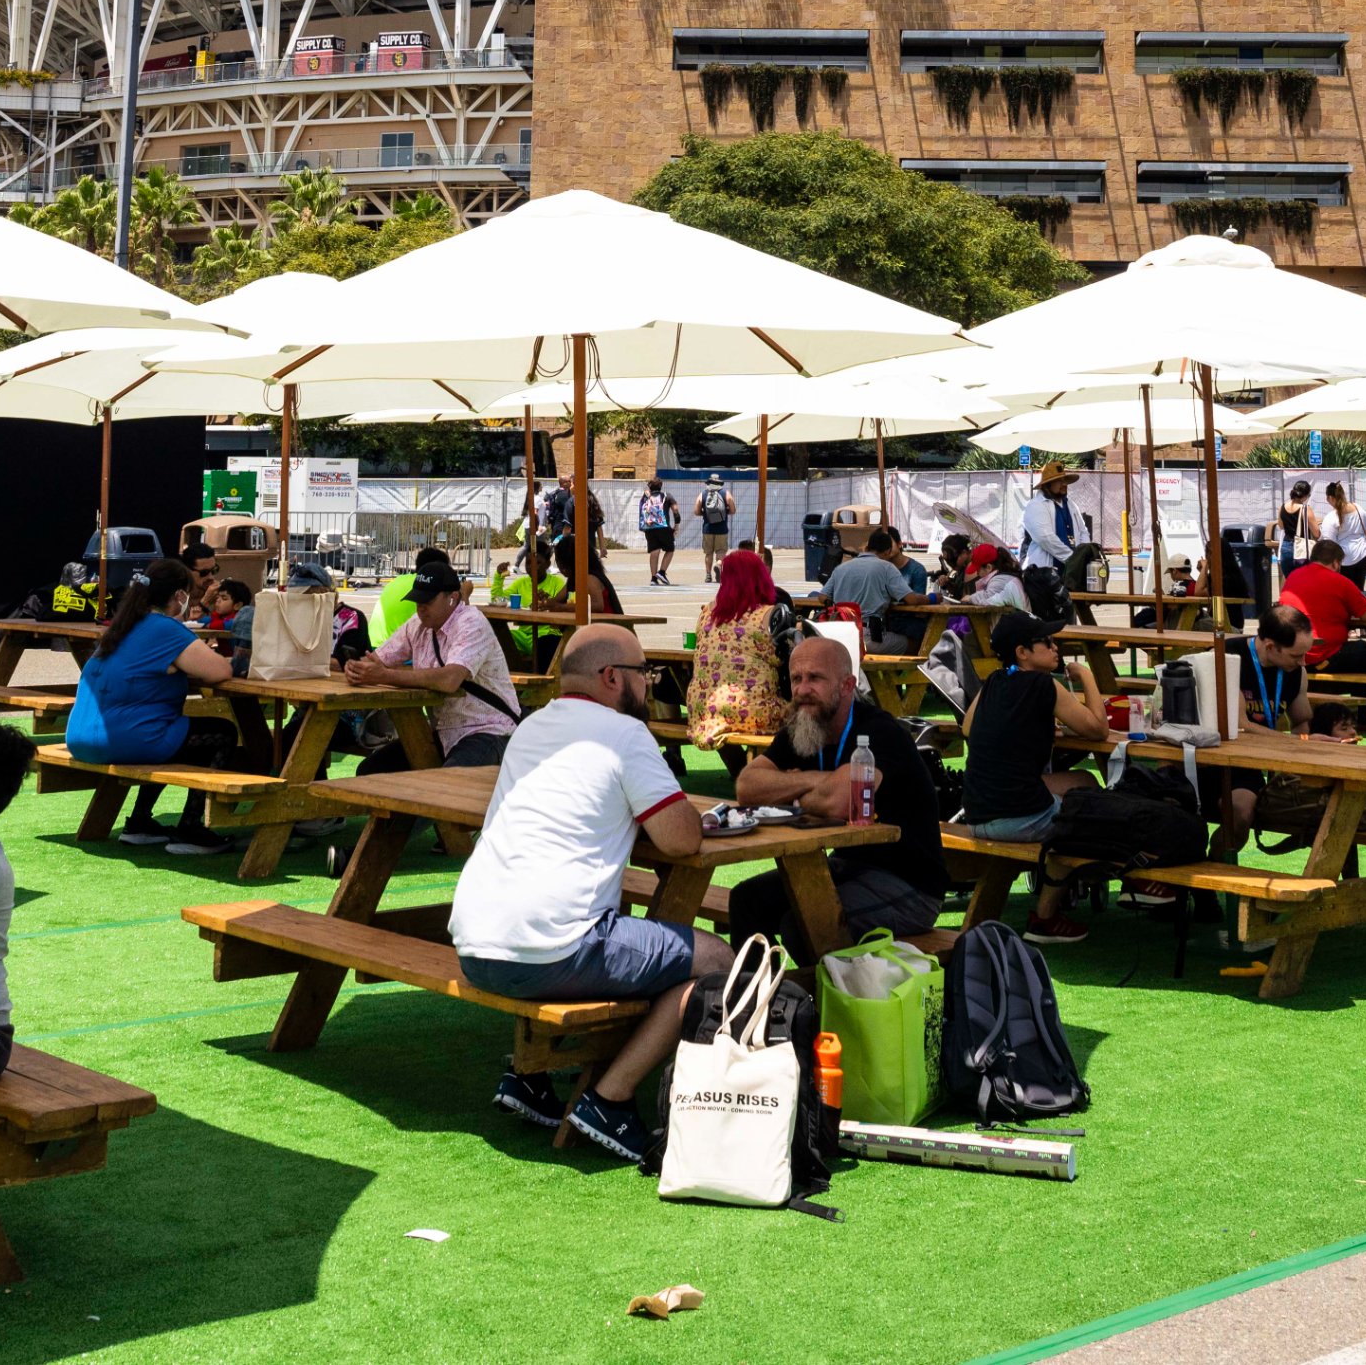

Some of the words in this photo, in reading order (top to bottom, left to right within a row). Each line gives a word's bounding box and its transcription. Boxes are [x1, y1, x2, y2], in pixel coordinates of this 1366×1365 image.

[296, 39, 321, 51] SUPPLY
[322, 38, 333, 49] CO.
[380, 34, 407, 46] SUPPLY
[409, 34, 423, 45] CO.
[674, 1091, 732, 1104] PEASUS
[736, 1093, 779, 1108] RISES
